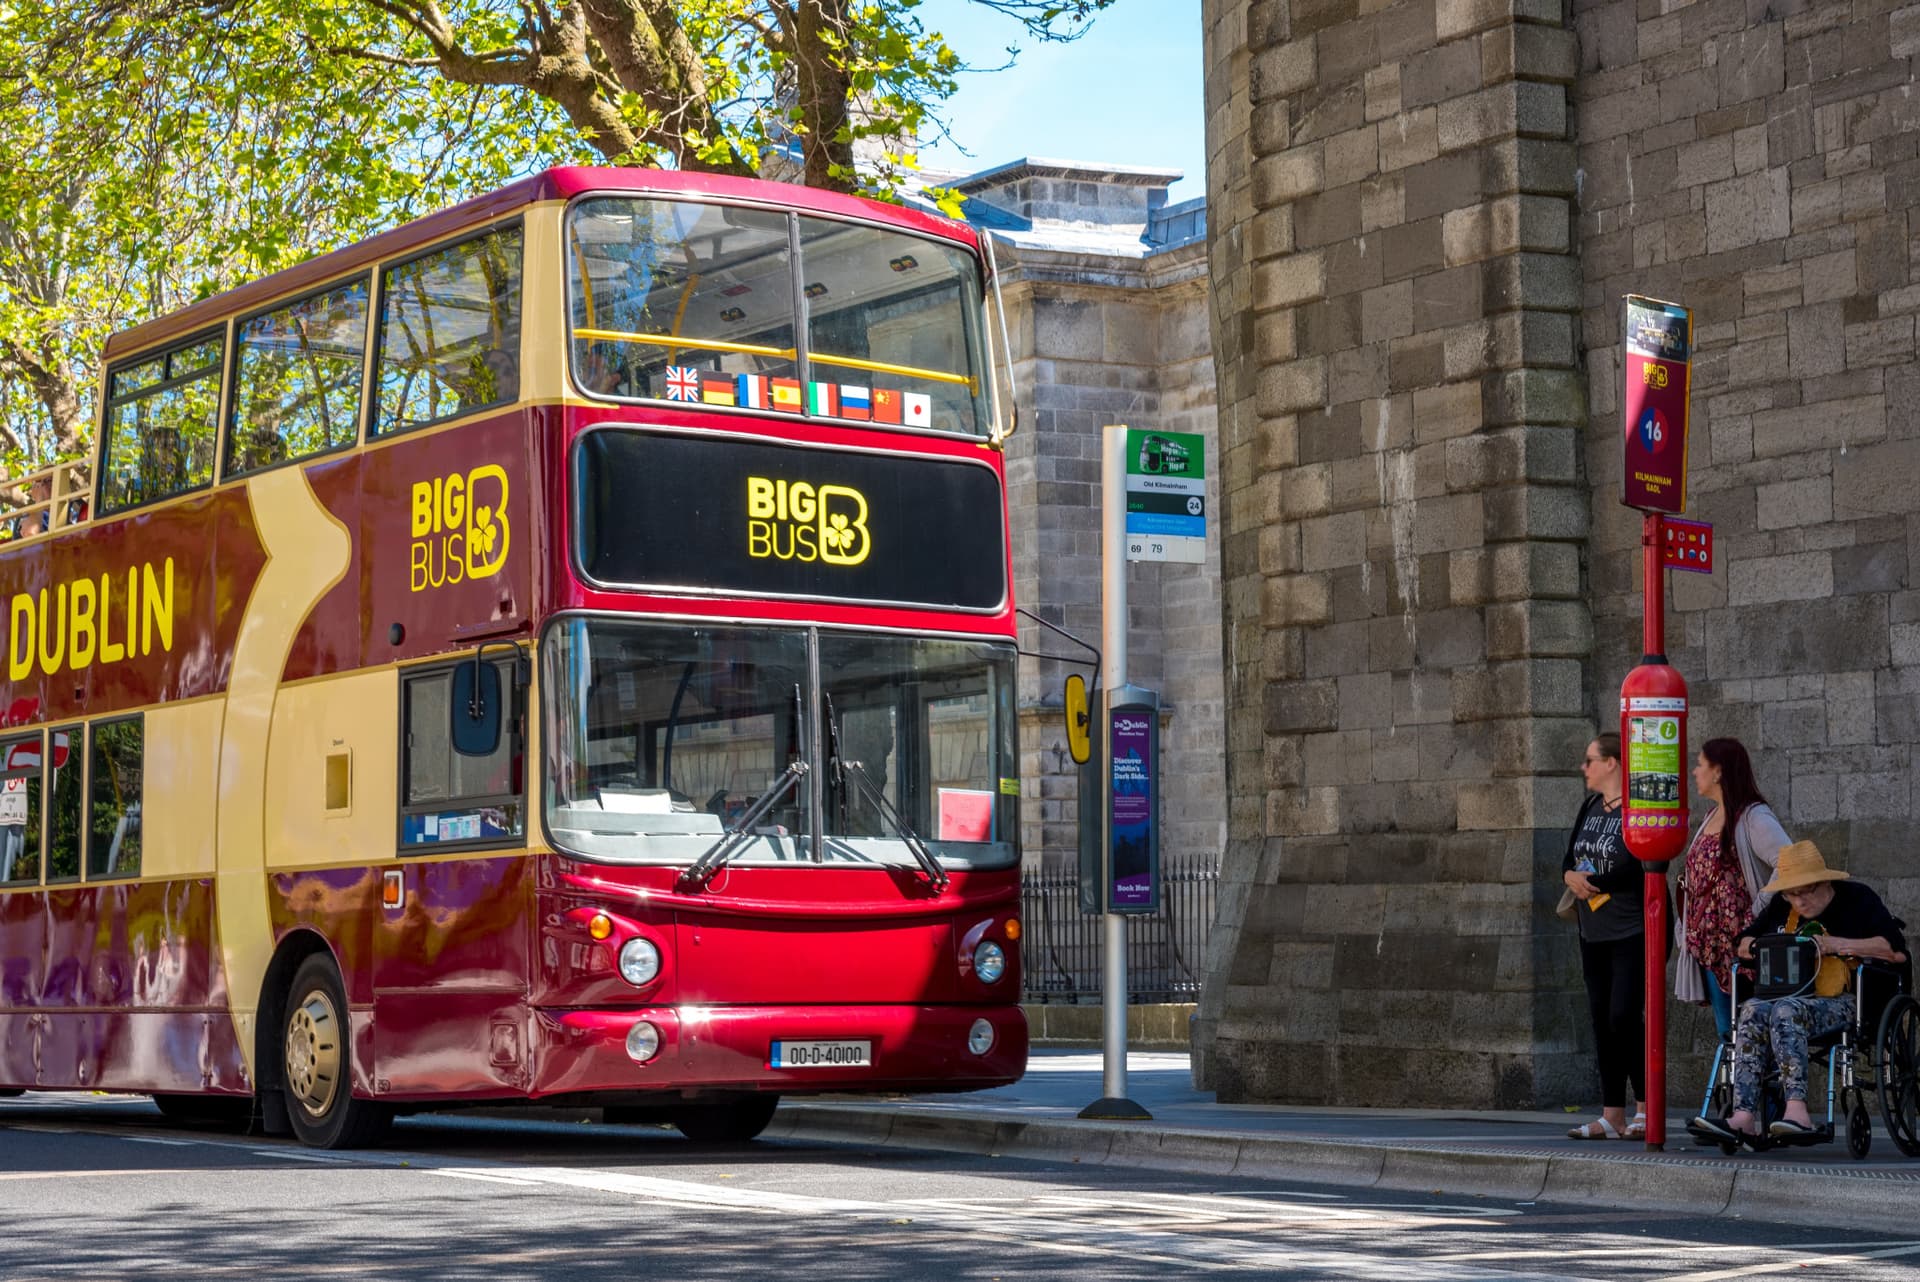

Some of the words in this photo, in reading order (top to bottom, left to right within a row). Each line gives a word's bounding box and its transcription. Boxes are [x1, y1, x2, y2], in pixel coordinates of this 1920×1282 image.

[1643, 361, 1657, 375] BIG
[1643, 373, 1657, 385] BUS
[1645, 420, 1663, 442] 16
[1635, 472, 1672, 486] KILMAINHAM
[1154, 482, 1188, 490] Kilmainham
[1645, 483, 1661, 494] GAOL
[411, 472, 466, 540] BIG
[747, 476, 816, 523] BIG
[1189, 502, 1200, 510] 24
[747, 519, 817, 563] BUS
[1131, 544, 1142, 553] 69
[1152, 544, 1163, 553] 79
[410, 536, 464, 593] BUS
[9, 556, 174, 682] DUBLIN
[1114, 719, 1149, 731] DoDublin
[1114, 764, 1140, 772] Dublin's
[1114, 772, 1130, 780] Dark
[1583, 815, 1604, 832] WIFE
[1117, 884, 1134, 892] Book
[1135, 884, 1150, 892] Now
[790, 1046, 862, 1065] 00-D-40100
